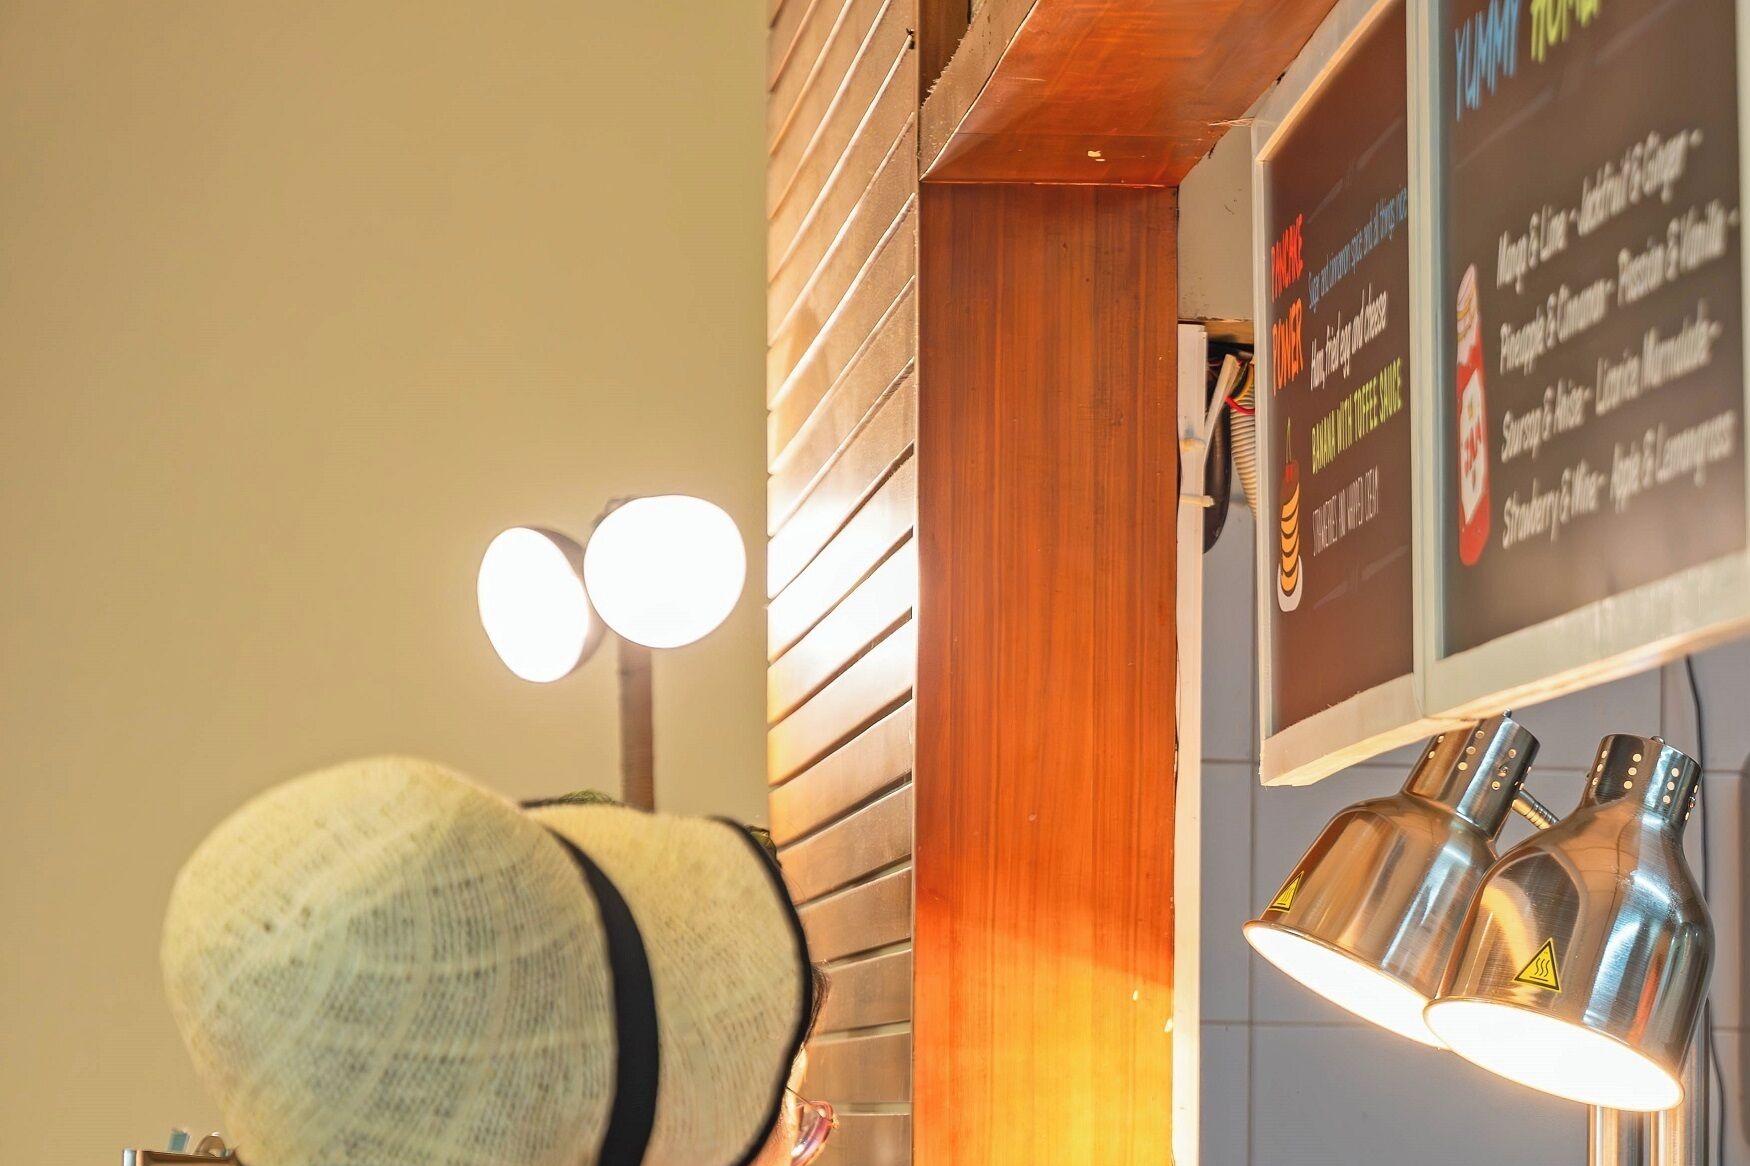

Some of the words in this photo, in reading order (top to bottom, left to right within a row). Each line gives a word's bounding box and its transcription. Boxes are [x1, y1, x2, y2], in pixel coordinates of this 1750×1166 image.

[1271, 213, 1304, 303] PANCAKE
[1272, 297, 1304, 398] POWER
[1364, 282, 1388, 345] cheese
[1311, 409, 1336, 476] BANANA
[1336, 392, 1353, 455] WITH
[1354, 375, 1378, 446] TOFFEE
[1379, 356, 1403, 424] SAUCE
